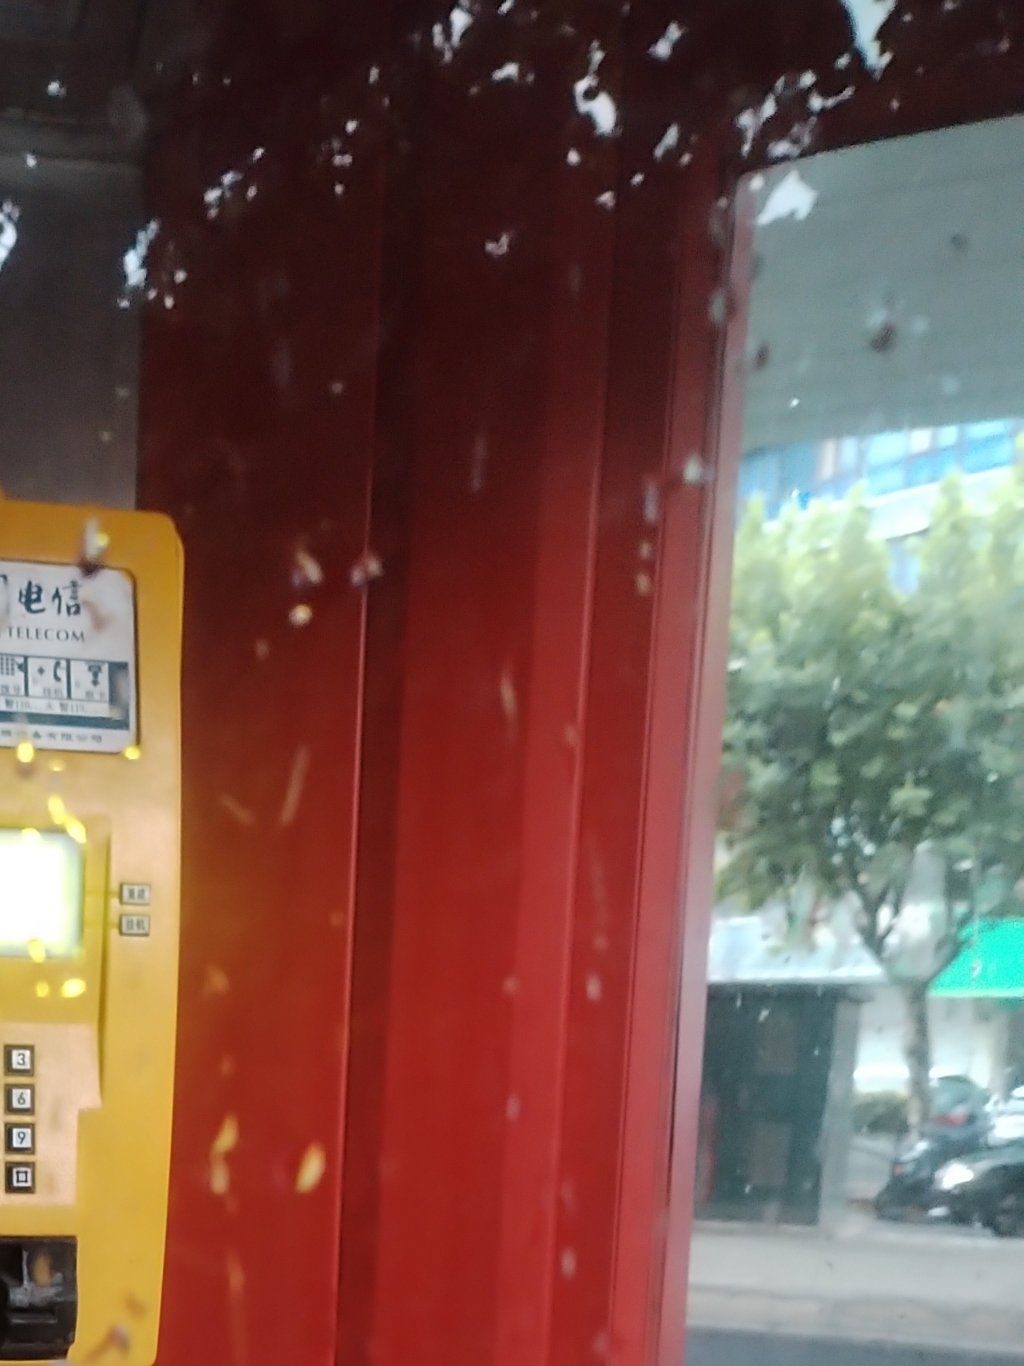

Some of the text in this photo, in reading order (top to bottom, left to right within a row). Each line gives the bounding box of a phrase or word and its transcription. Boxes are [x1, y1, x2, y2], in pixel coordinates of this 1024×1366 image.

[8, 625, 86, 643] TELECOM
[17, 1053, 26, 1066] 3
[17, 1092, 26, 1105] 6
[17, 1131, 26, 1144] 9
